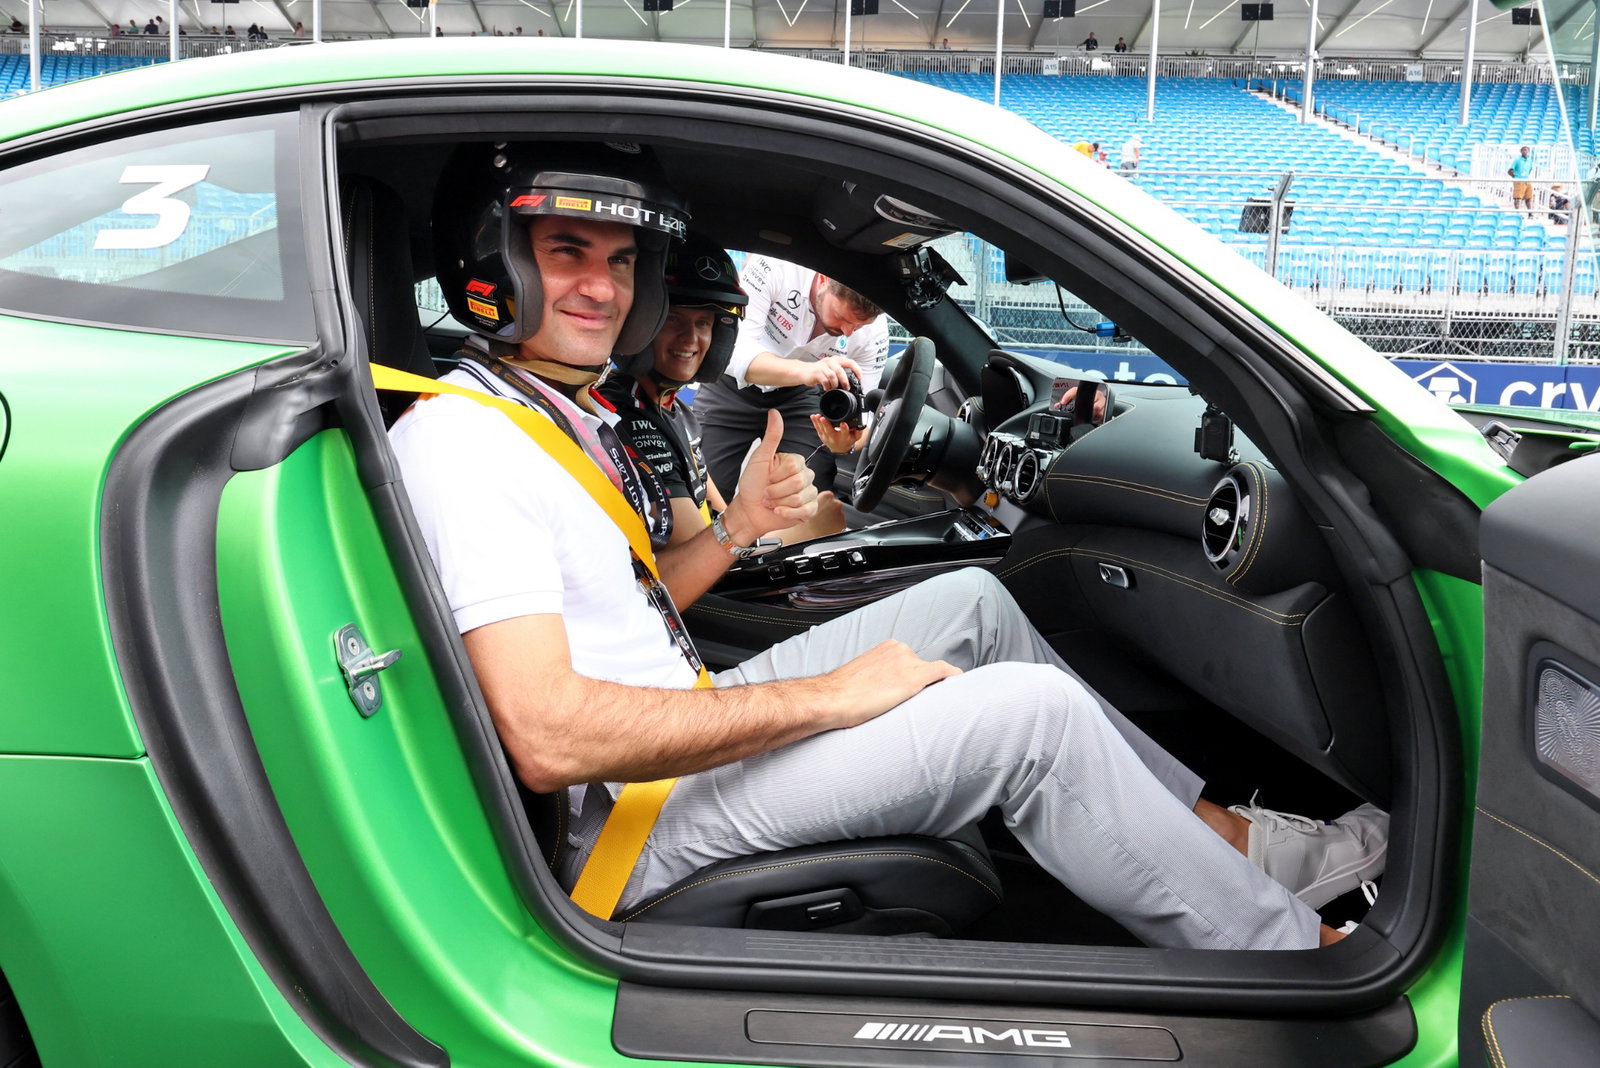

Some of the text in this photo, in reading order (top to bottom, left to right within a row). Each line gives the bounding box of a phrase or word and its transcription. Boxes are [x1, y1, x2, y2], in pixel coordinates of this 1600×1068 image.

[93, 164, 210, 250] 3
[509, 194, 548, 207] F1
[558, 199, 588, 209] PIRELLI
[595, 200, 655, 222] HOT
[465, 279, 496, 297] F1
[776, 314, 794, 331] UBS
[635, 439, 667, 449] ONVOY
[626, 485, 642, 513] HOT
[650, 474, 667, 505] HOT
[922, 1023, 1072, 1048] AMG
